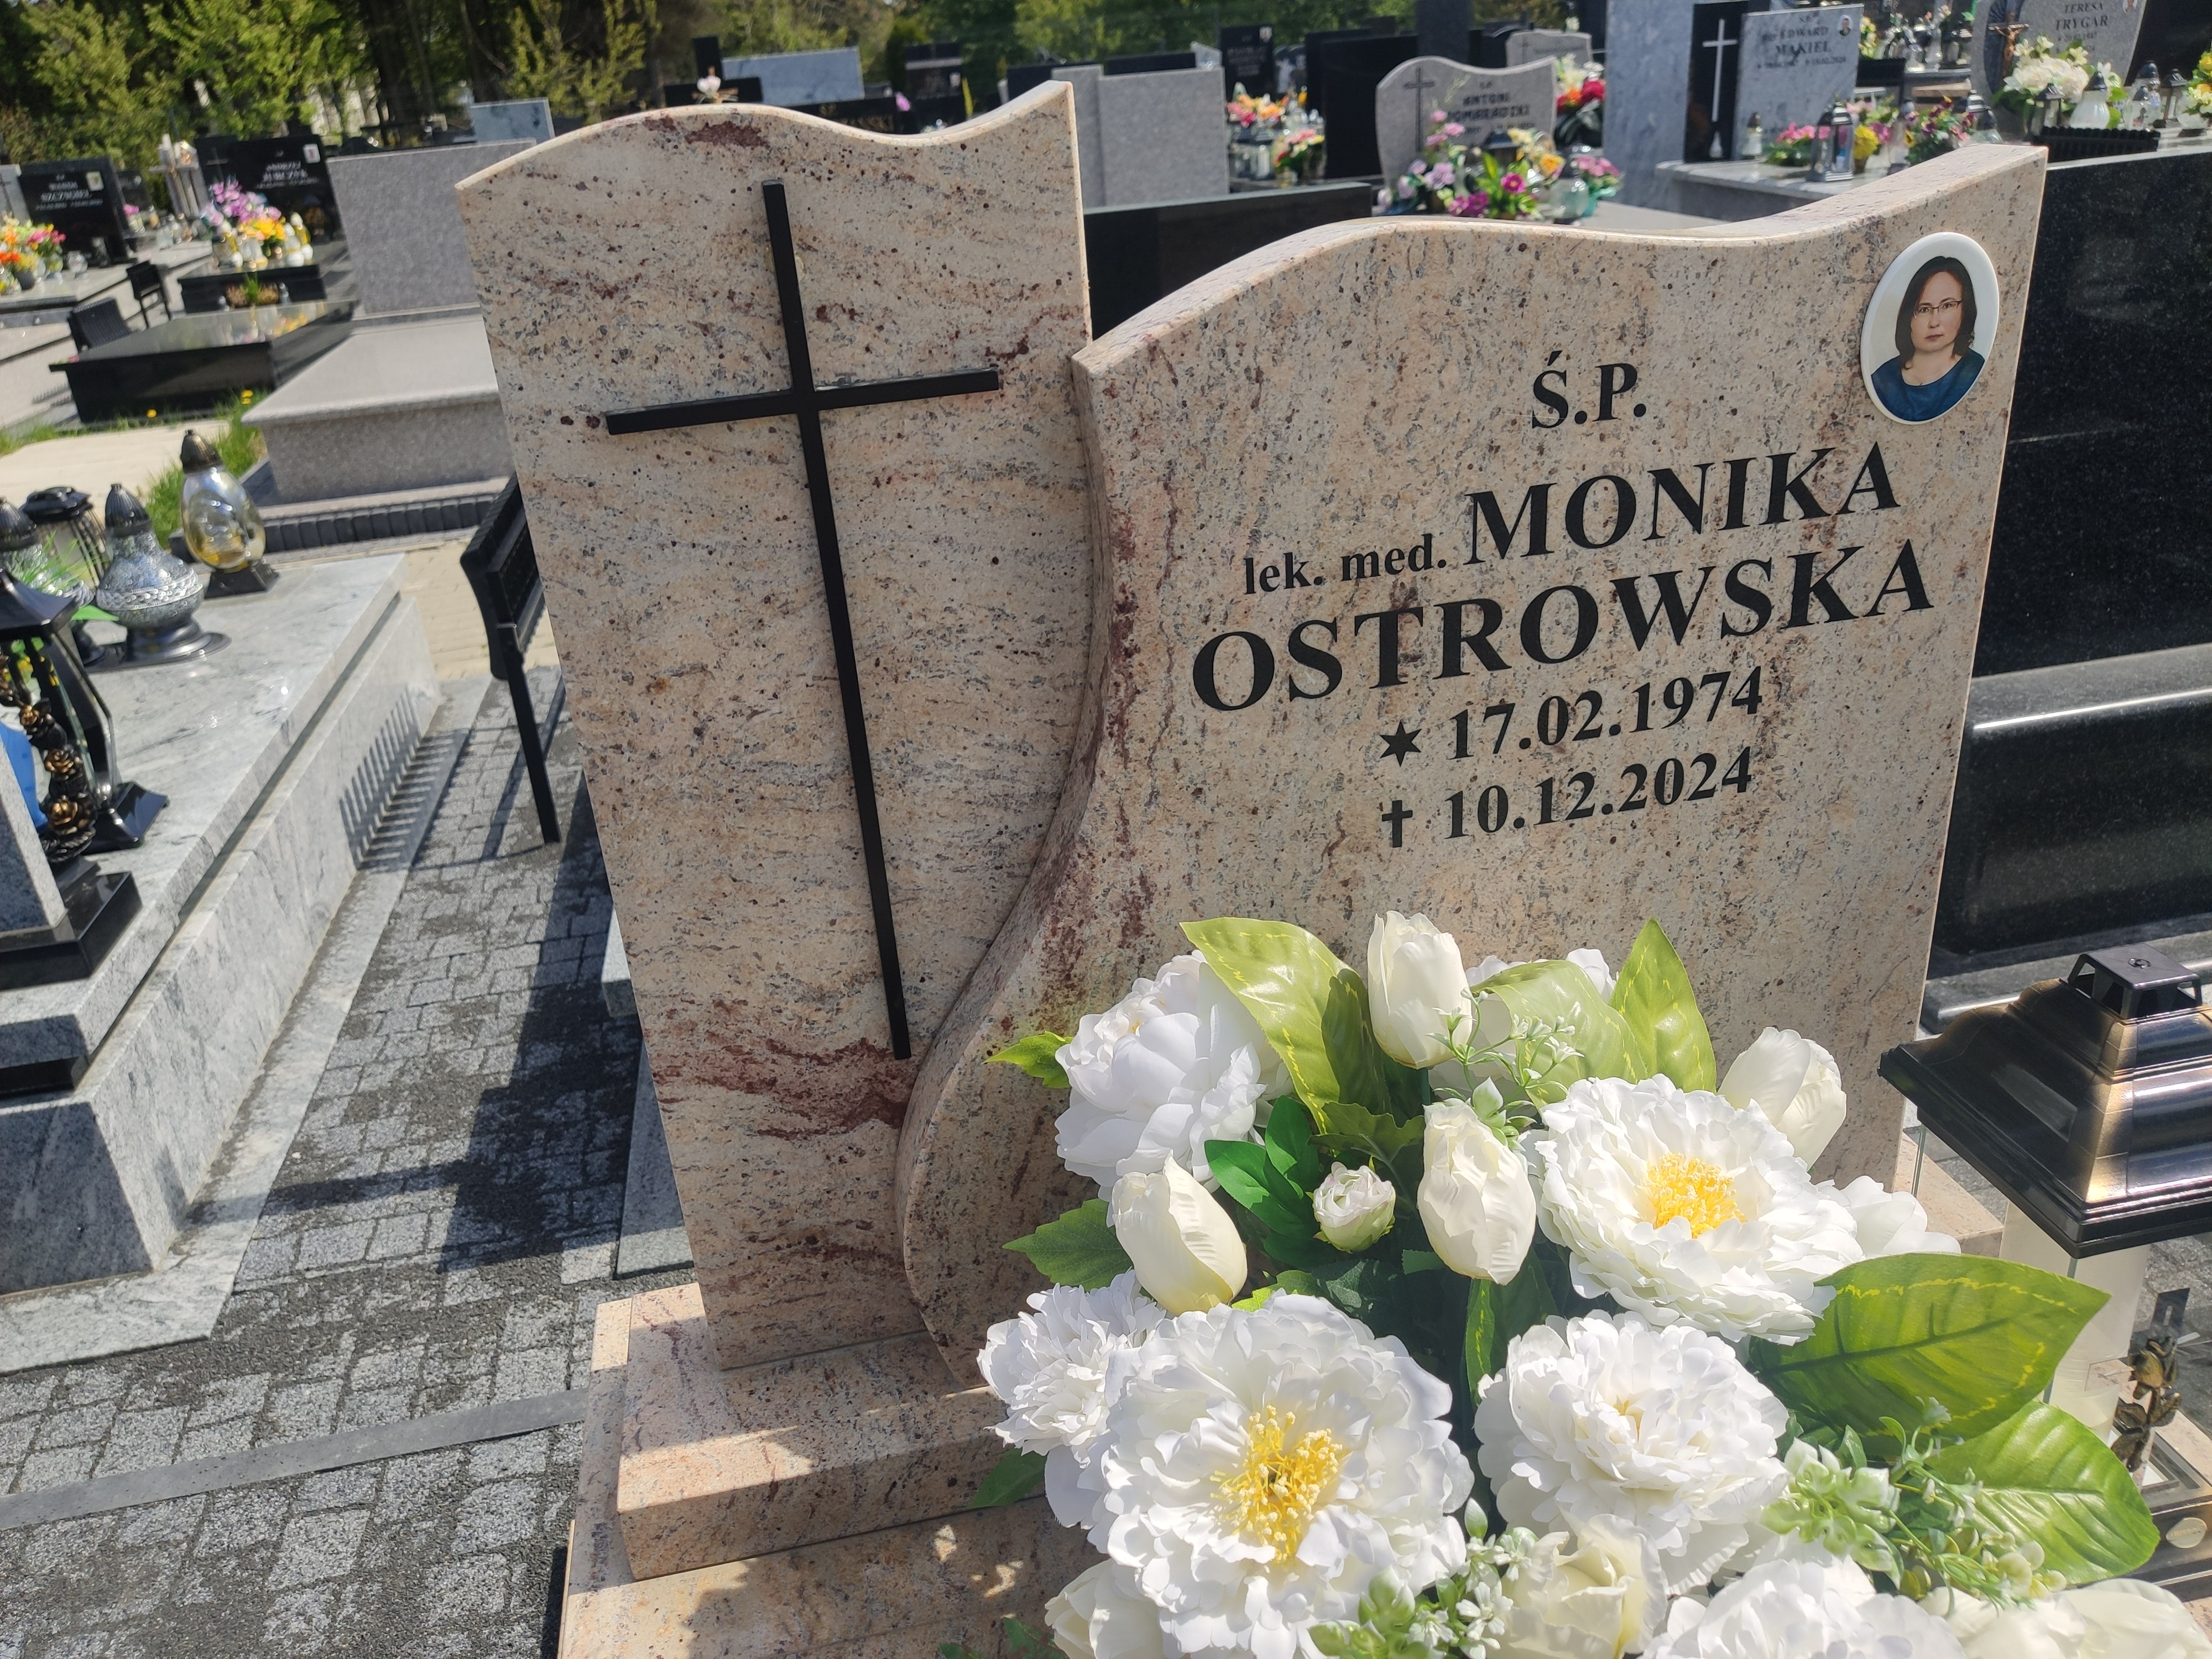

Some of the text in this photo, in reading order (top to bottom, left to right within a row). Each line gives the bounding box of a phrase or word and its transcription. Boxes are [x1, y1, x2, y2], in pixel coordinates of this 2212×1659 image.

[2055, 15, 2109, 30] TRYGAR
[1532, 351, 1646, 430] Ś.P.
[1243, 441, 1901, 596] lek. med. MONIKA
[1192, 538, 1934, 711] OSTROWSKA
[1448, 665, 1762, 760] 17.02.1974
[1444, 746, 1752, 839] 10.12.2024
